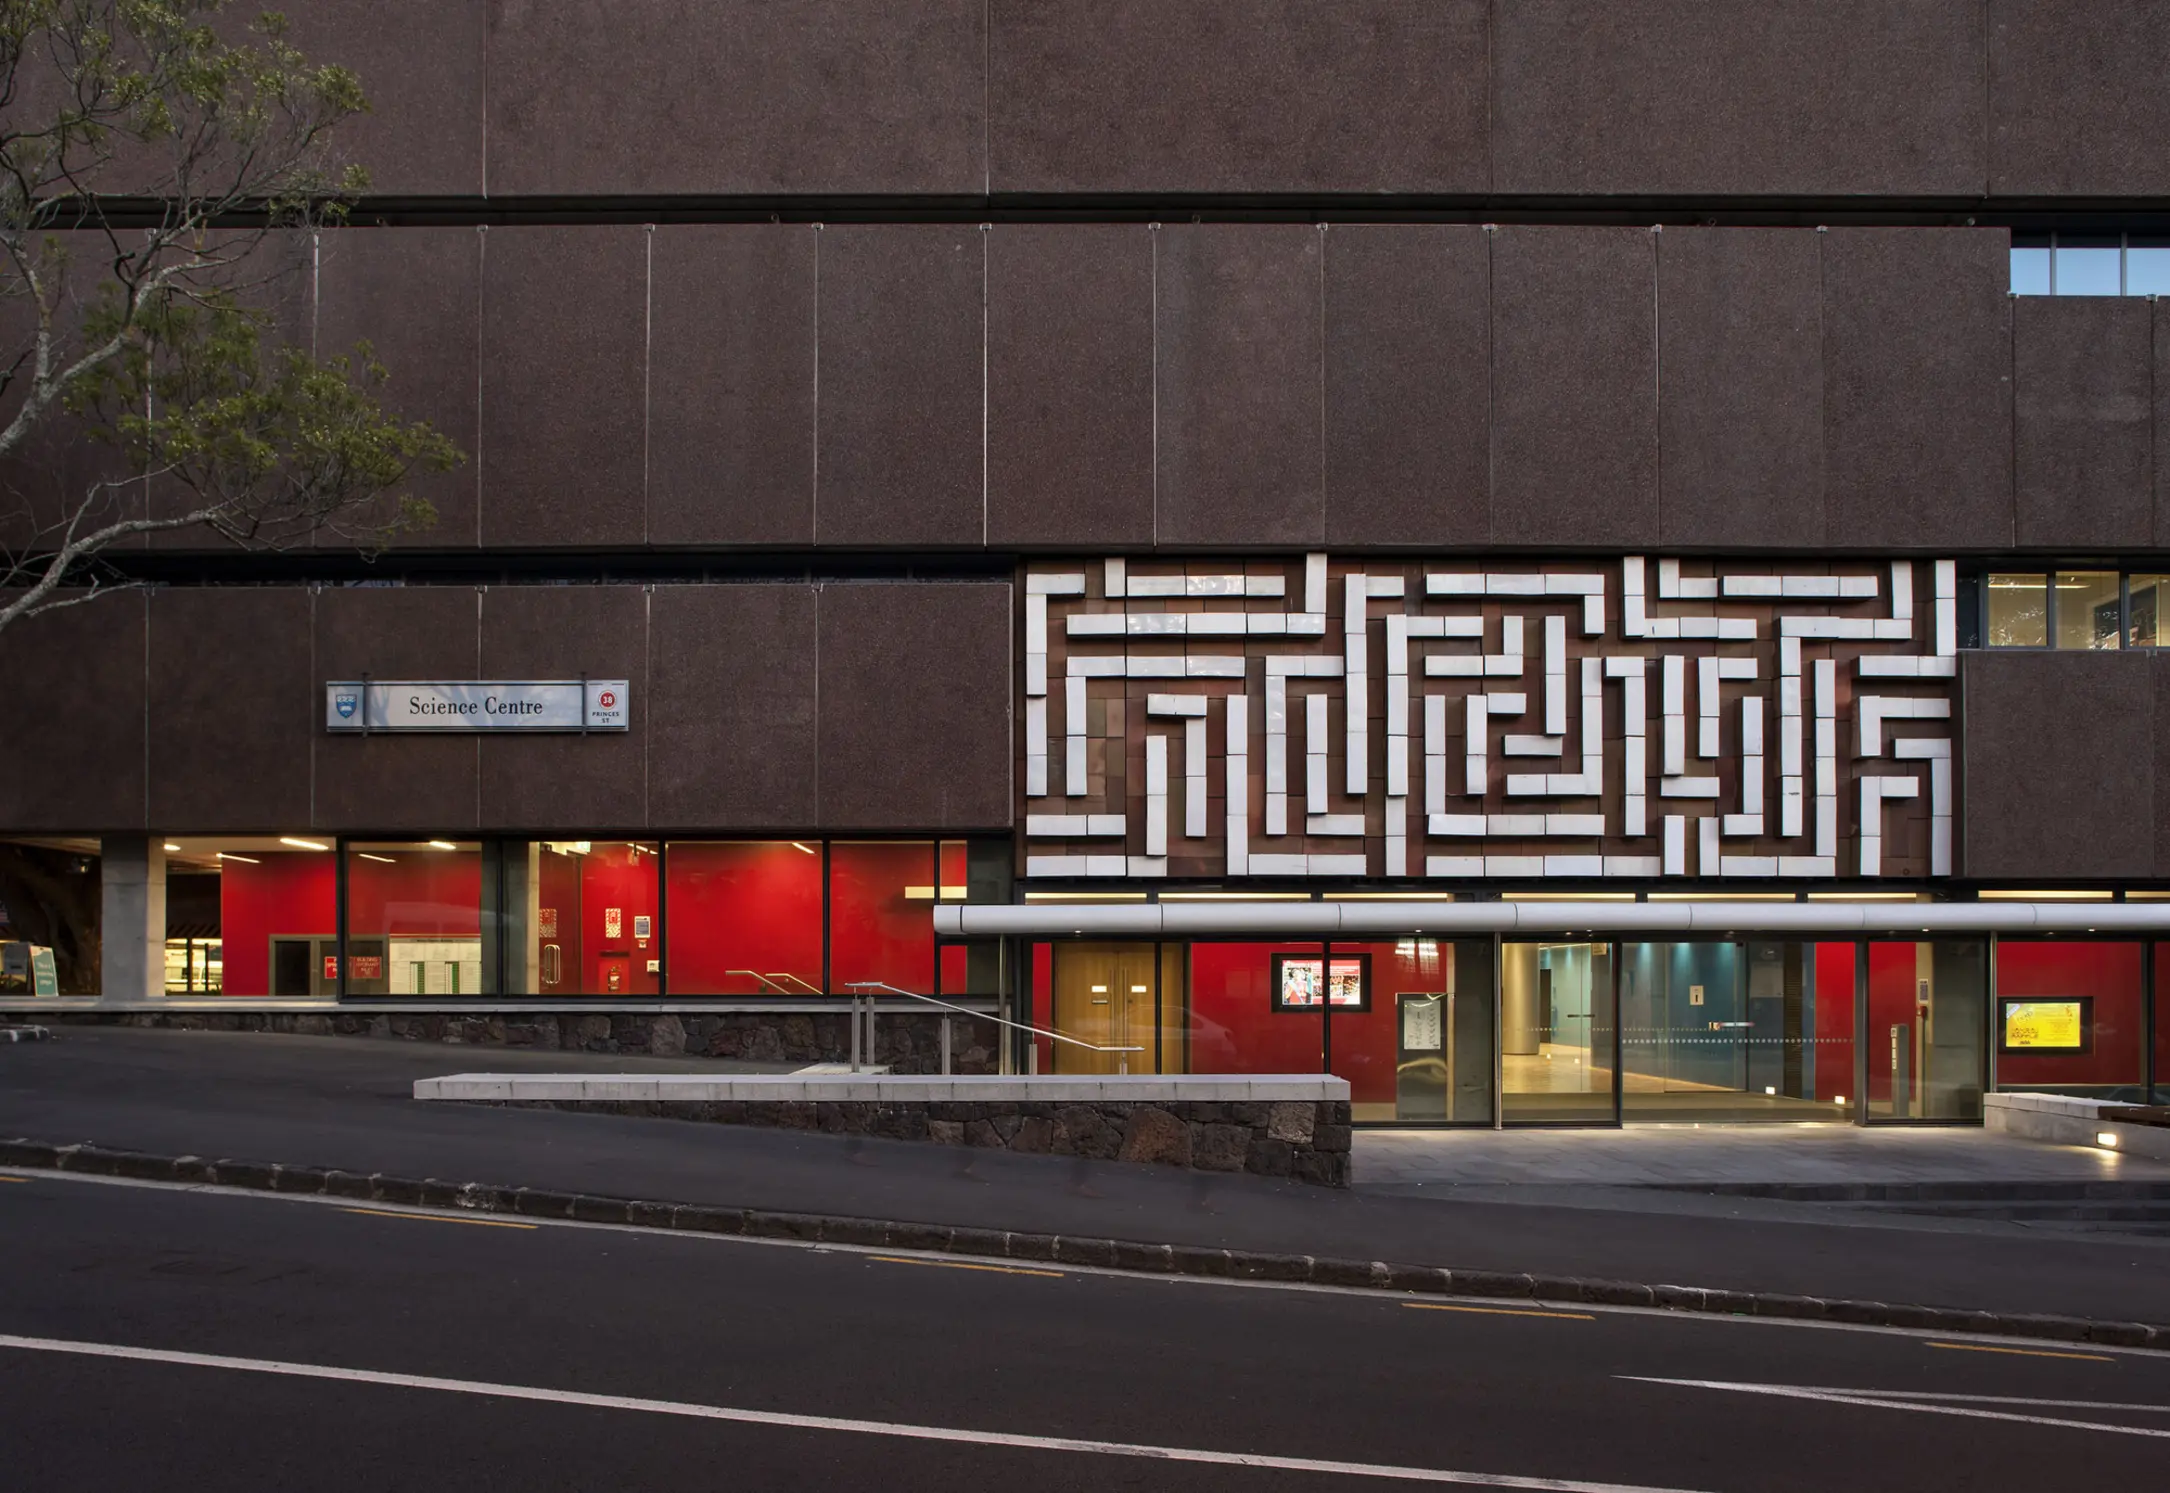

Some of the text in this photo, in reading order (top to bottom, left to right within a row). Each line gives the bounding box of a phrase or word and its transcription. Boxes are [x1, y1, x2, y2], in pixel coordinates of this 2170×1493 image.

[409, 696, 543, 715] Science Centre
[603, 696, 613, 704] 38
